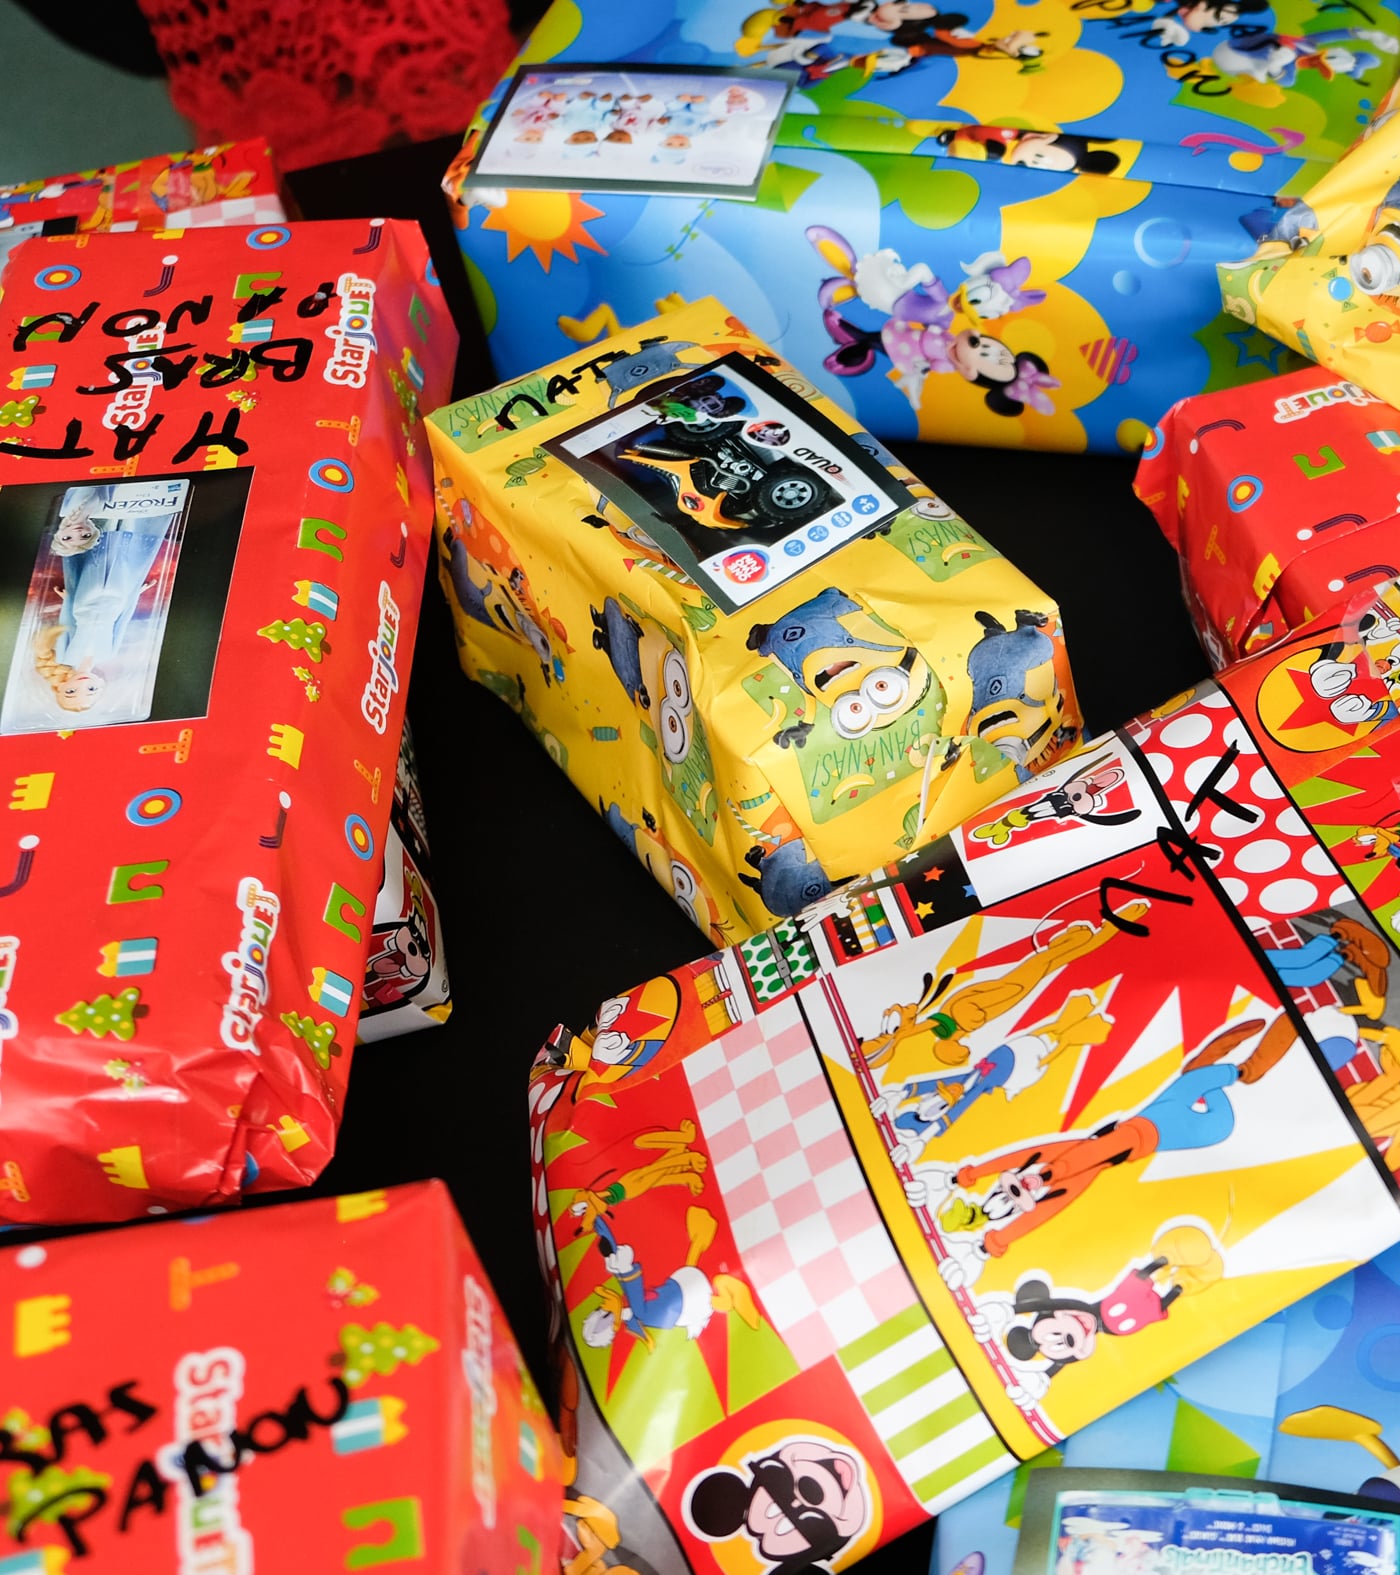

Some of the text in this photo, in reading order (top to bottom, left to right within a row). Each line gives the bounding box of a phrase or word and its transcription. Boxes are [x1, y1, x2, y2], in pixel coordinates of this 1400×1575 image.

[793, 447, 842, 475] QUAD
[103, 496, 178, 512] FROZEN
[727, 562, 748, 581] ONE
[741, 554, 763, 574] FUN
[812, 720, 920, 787] BANANAS!
